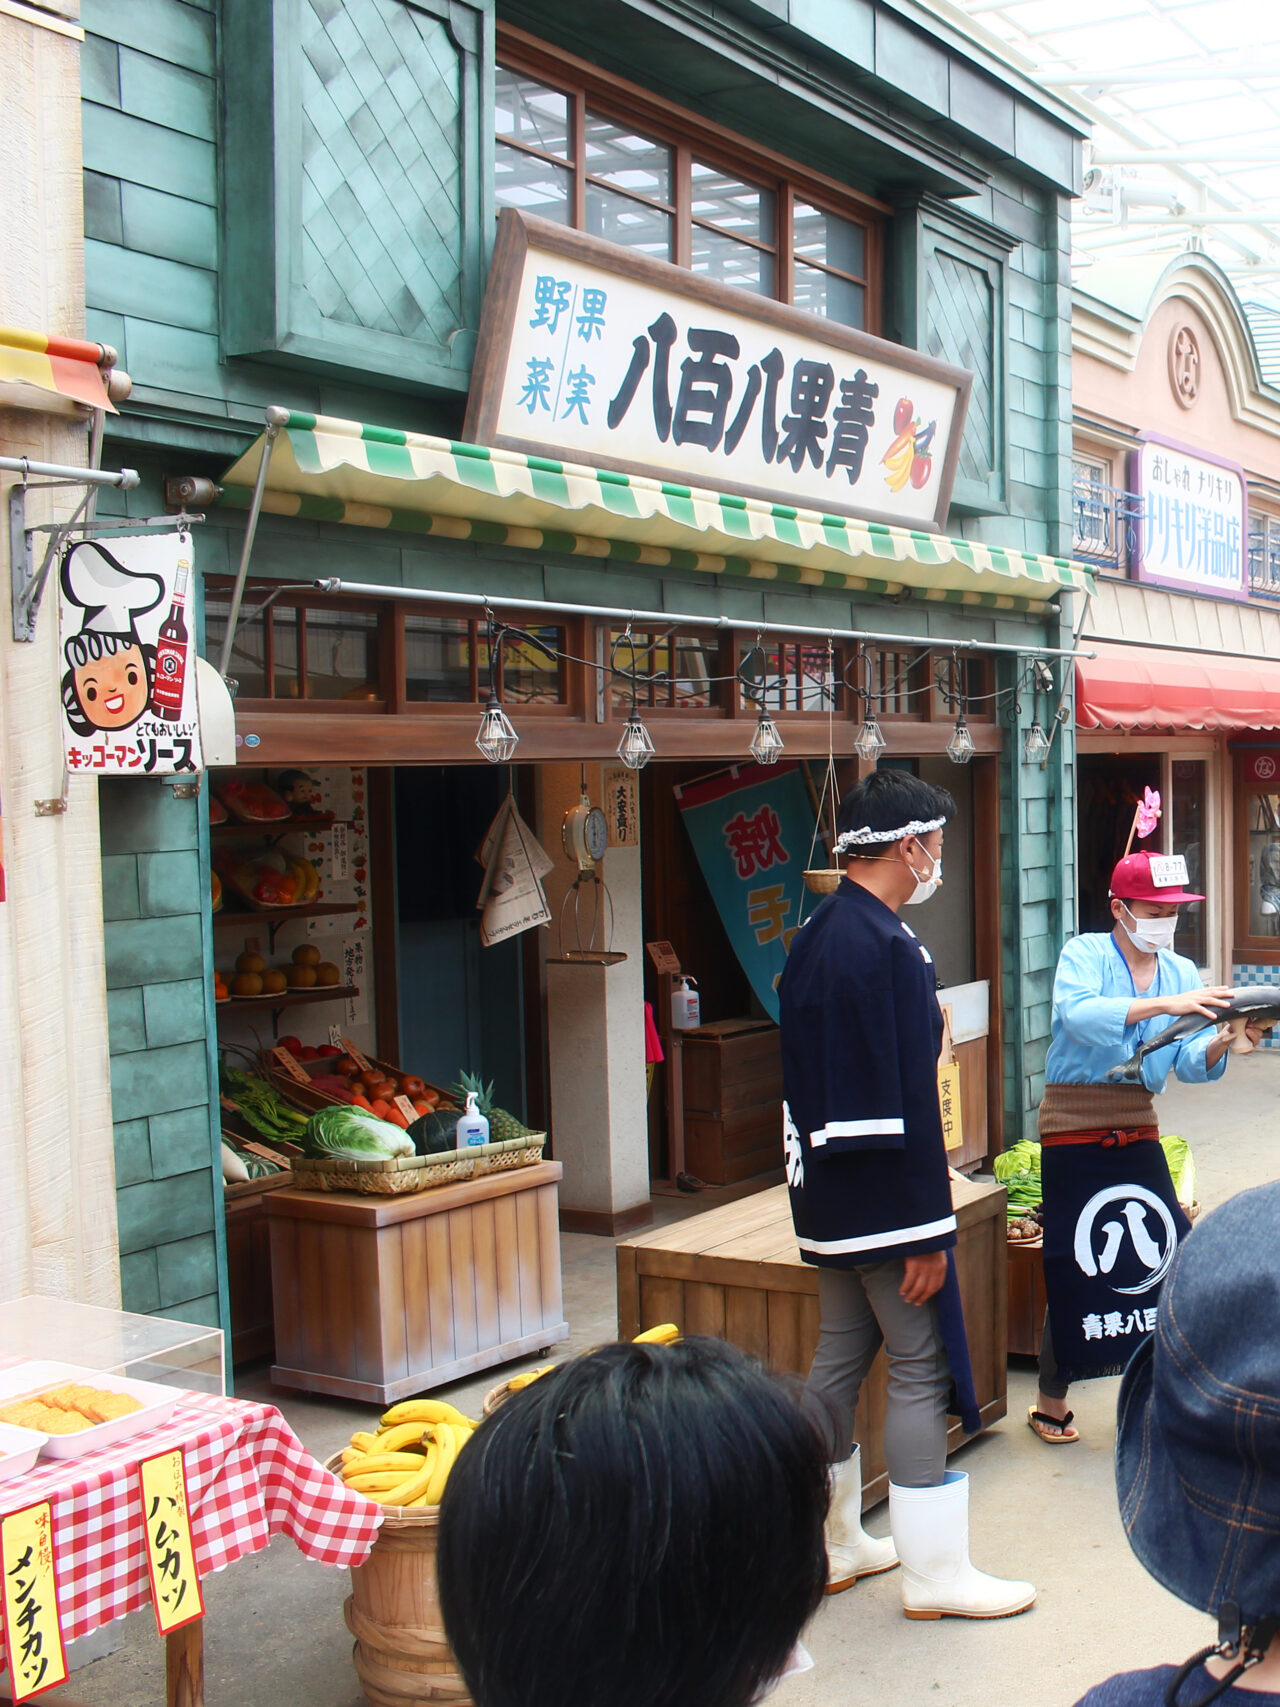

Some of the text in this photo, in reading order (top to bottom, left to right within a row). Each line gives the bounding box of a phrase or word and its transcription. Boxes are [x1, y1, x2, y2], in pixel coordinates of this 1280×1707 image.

[516, 275, 572, 415] 野菜
[561, 287, 608, 426] 果実
[1144, 489, 1240, 581] ナリキリ洋品店
[1152, 455, 1232, 505] おしゃれ ナリキリ
[941, 1079, 953, 1138] 支度中
[147, 1496, 188, 1614] ハムカツ
[8, 1545, 48, 1690] メンチカツ
